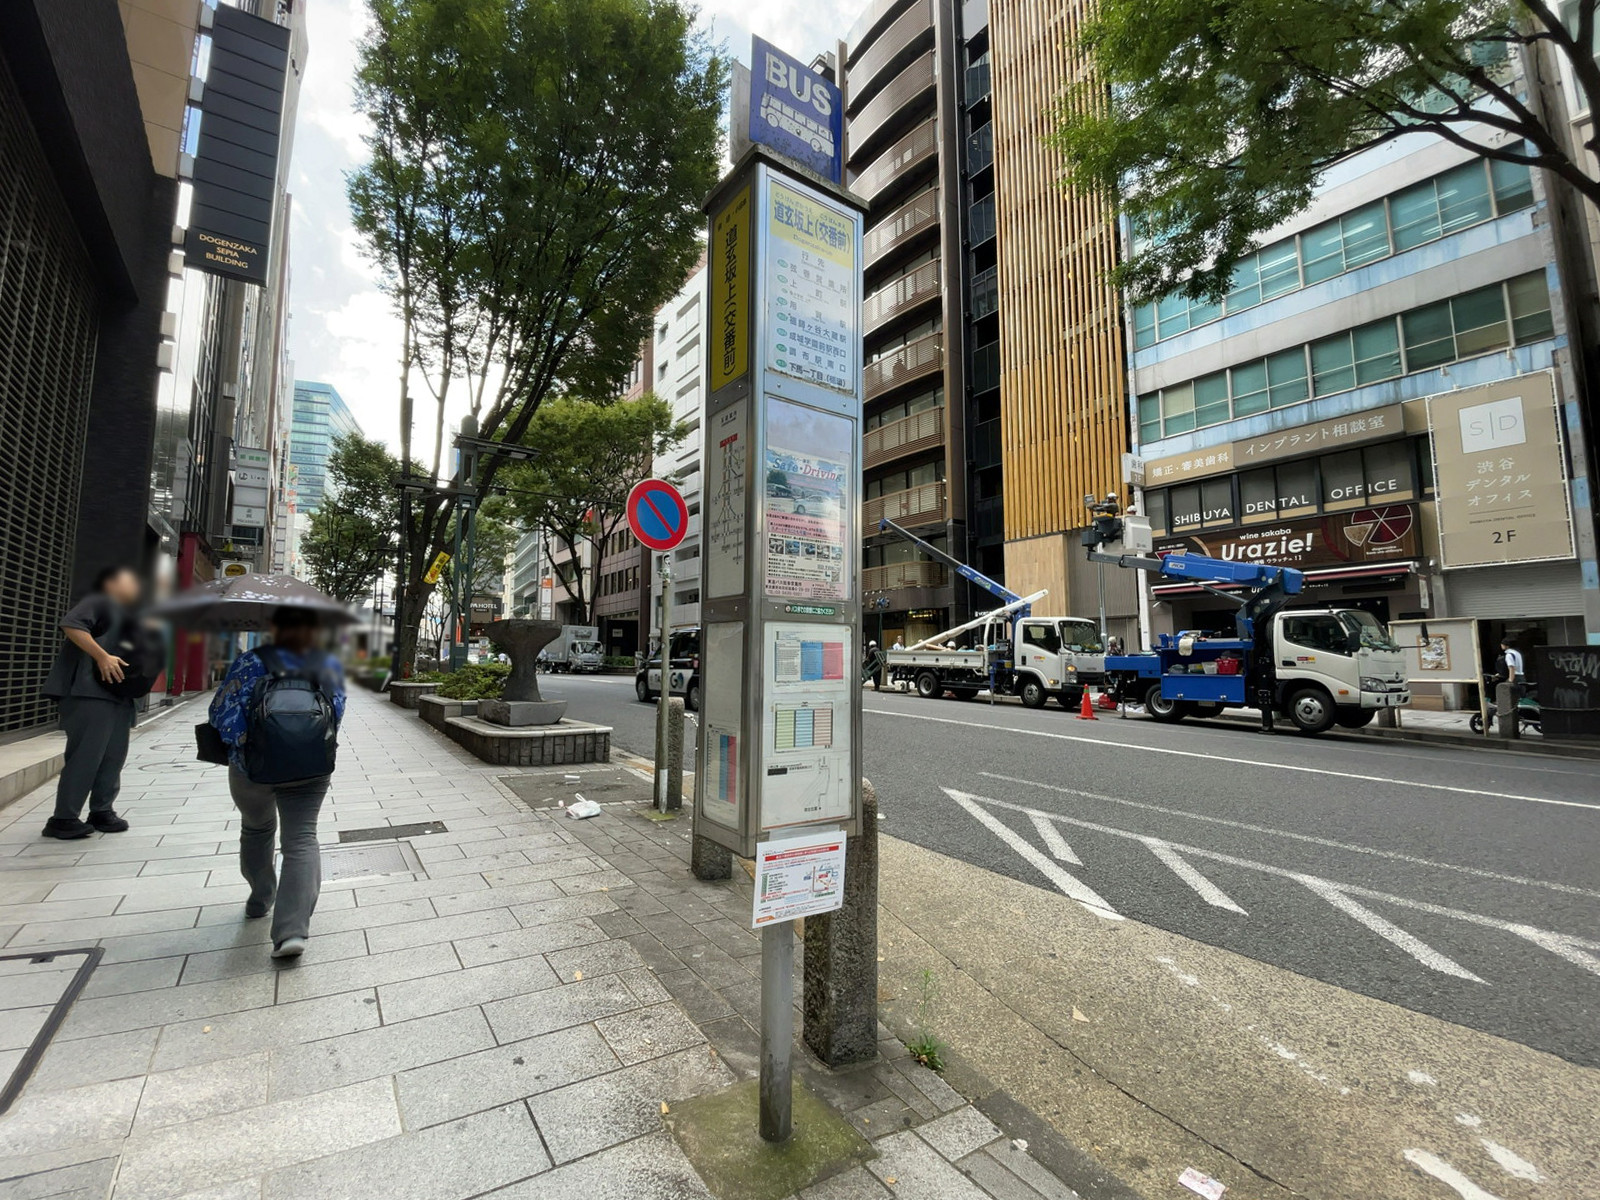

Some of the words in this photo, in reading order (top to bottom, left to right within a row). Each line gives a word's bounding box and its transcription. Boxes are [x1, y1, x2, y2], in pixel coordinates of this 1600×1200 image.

[765, 51, 832, 116] BUS
[199, 233, 258, 255] DOGENZAKA
[216, 246, 240, 258] SEPIA
[205, 252, 249, 269] BUILDING
[723, 224, 738, 376] 道玄坂上(交番前)
[1244, 415, 1386, 457] インプラント相談室
[773, 457, 799, 473] Safe
[802, 463, 842, 483] Driving
[1152, 451, 1230, 478] 矯正・審美歯科
[1476, 457, 1516, 474] 渋谷
[1465, 473, 1532, 491] デンタル
[1174, 507, 1231, 526] SHIBUYA
[1245, 494, 1310, 514] DENTAL
[1330, 479, 1398, 500] OFFICE
[1467, 489, 1533, 507] オフィス
[1240, 532, 1259, 541] wine
[1261, 528, 1292, 538] sakaba
[1491, 529, 1517, 544] 2F
[1221, 533, 1314, 561] Urazie!
